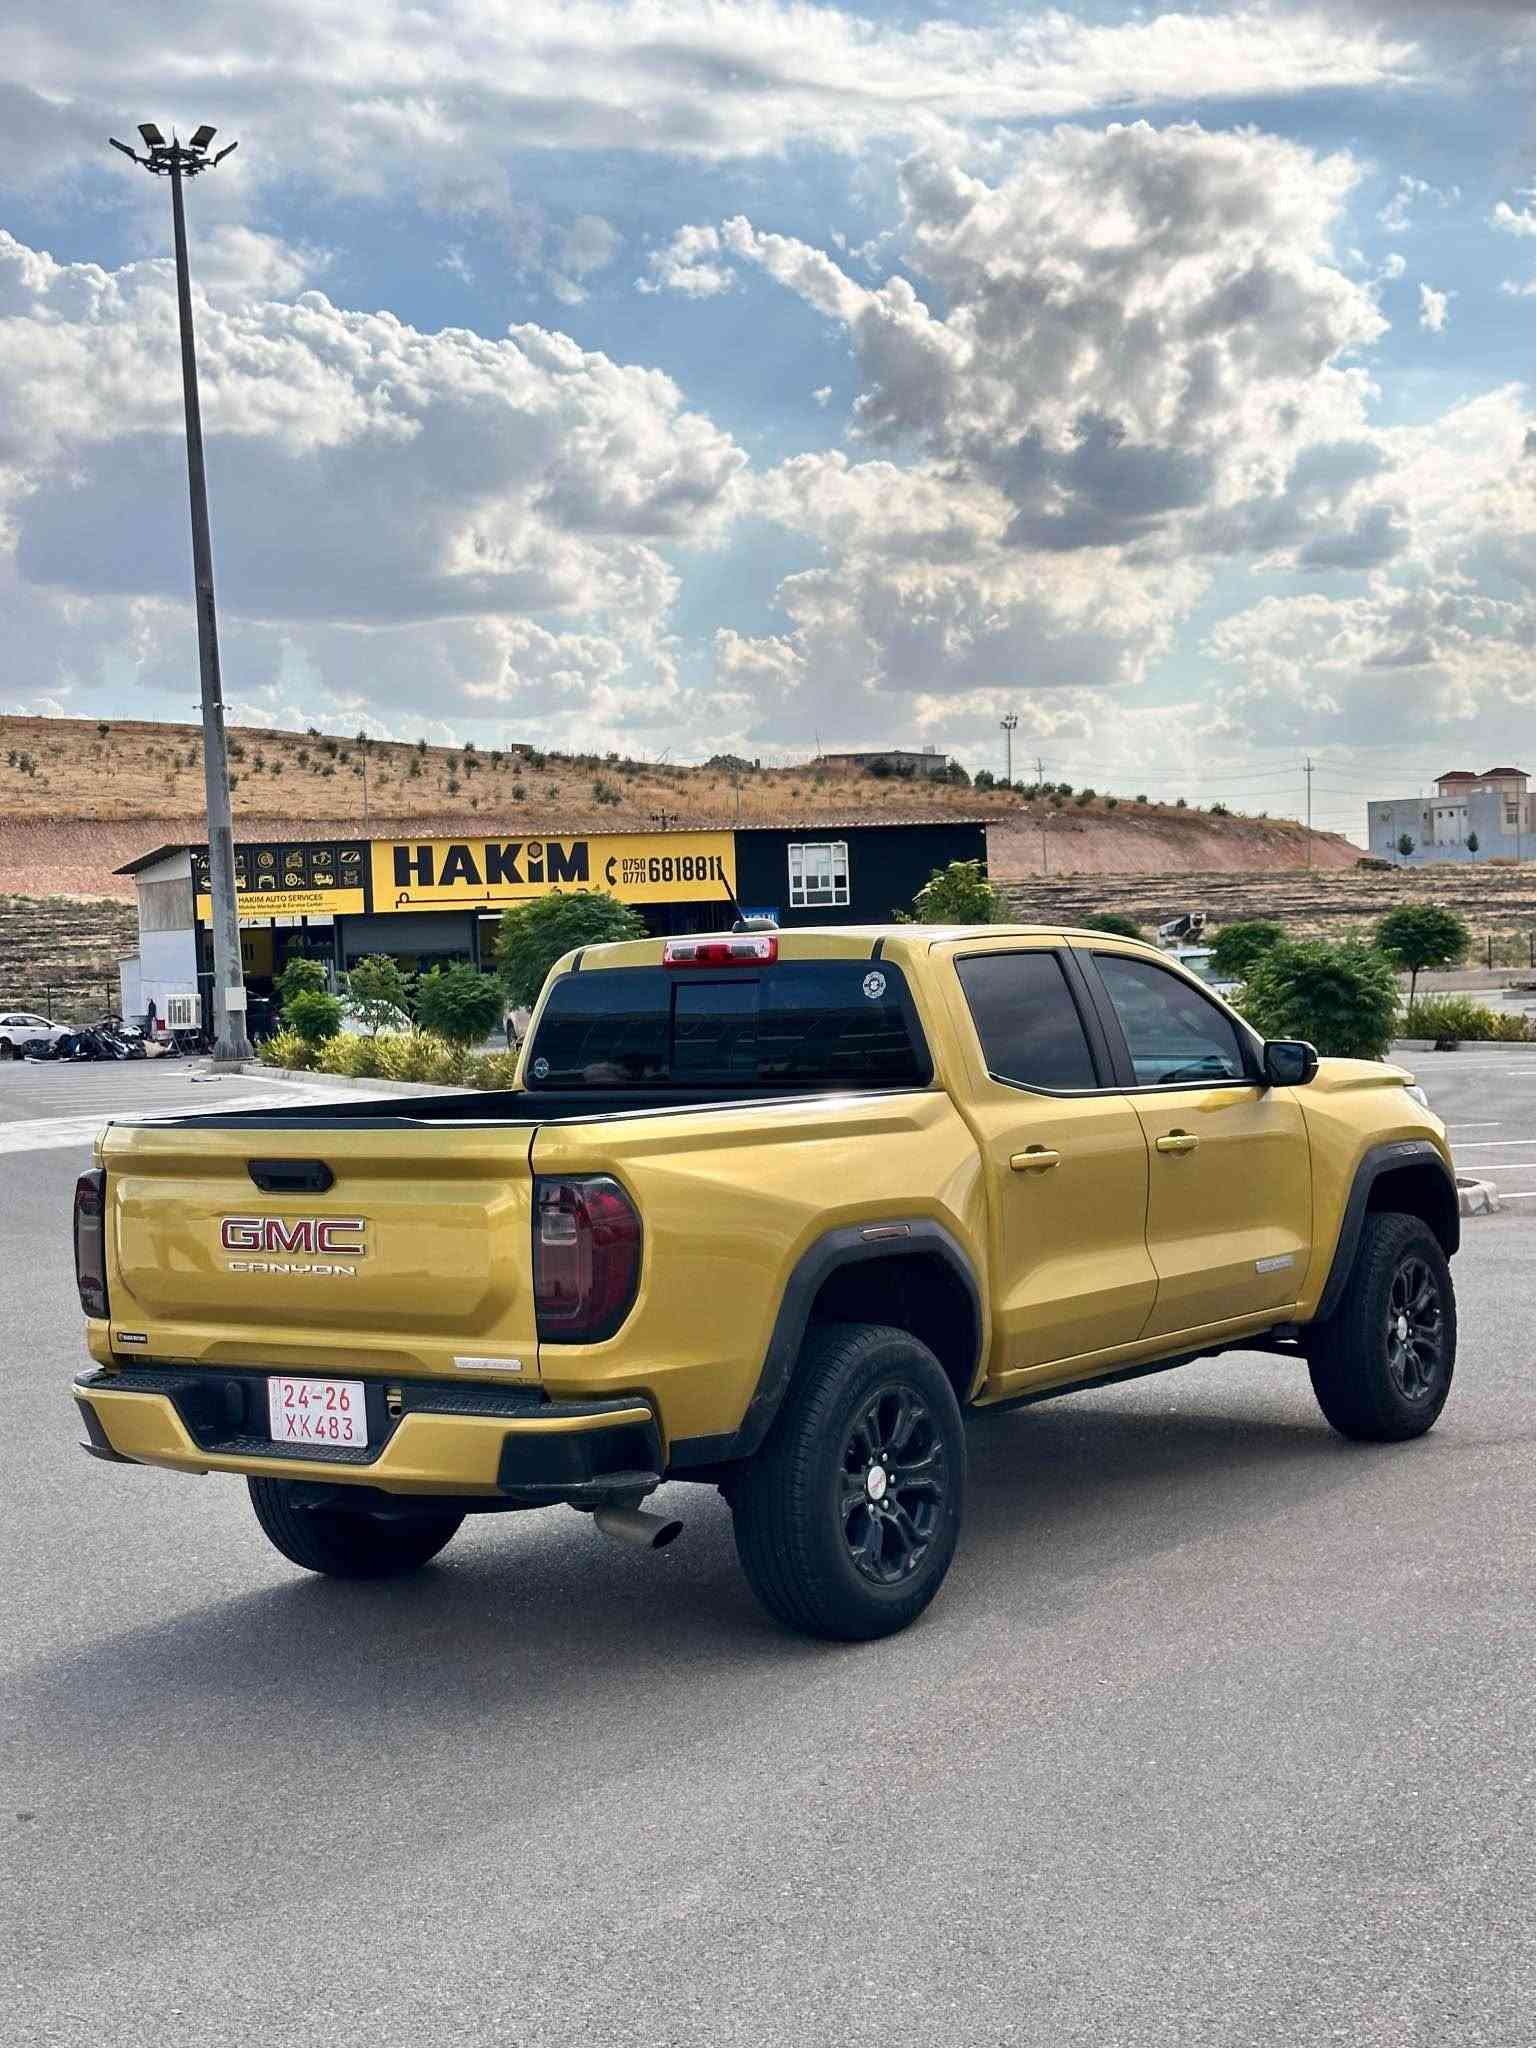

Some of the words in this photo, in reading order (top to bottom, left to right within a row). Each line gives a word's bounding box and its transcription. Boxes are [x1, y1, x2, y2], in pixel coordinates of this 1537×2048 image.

[622, 858, 645, 871] 0750
[648, 855, 722, 882] 6818811
[623, 871, 646, 884] 0770
[239, 895, 264, 904] HAKIM
[265, 894, 287, 903] AUTO
[288, 893, 323, 902] SERVICES
[221, 1217, 365, 1255] GMC
[228, 1261, 357, 1277] CANYON
[284, 1384, 350, 1411] 24-26
[286, 1413, 353, 1440] XK483
